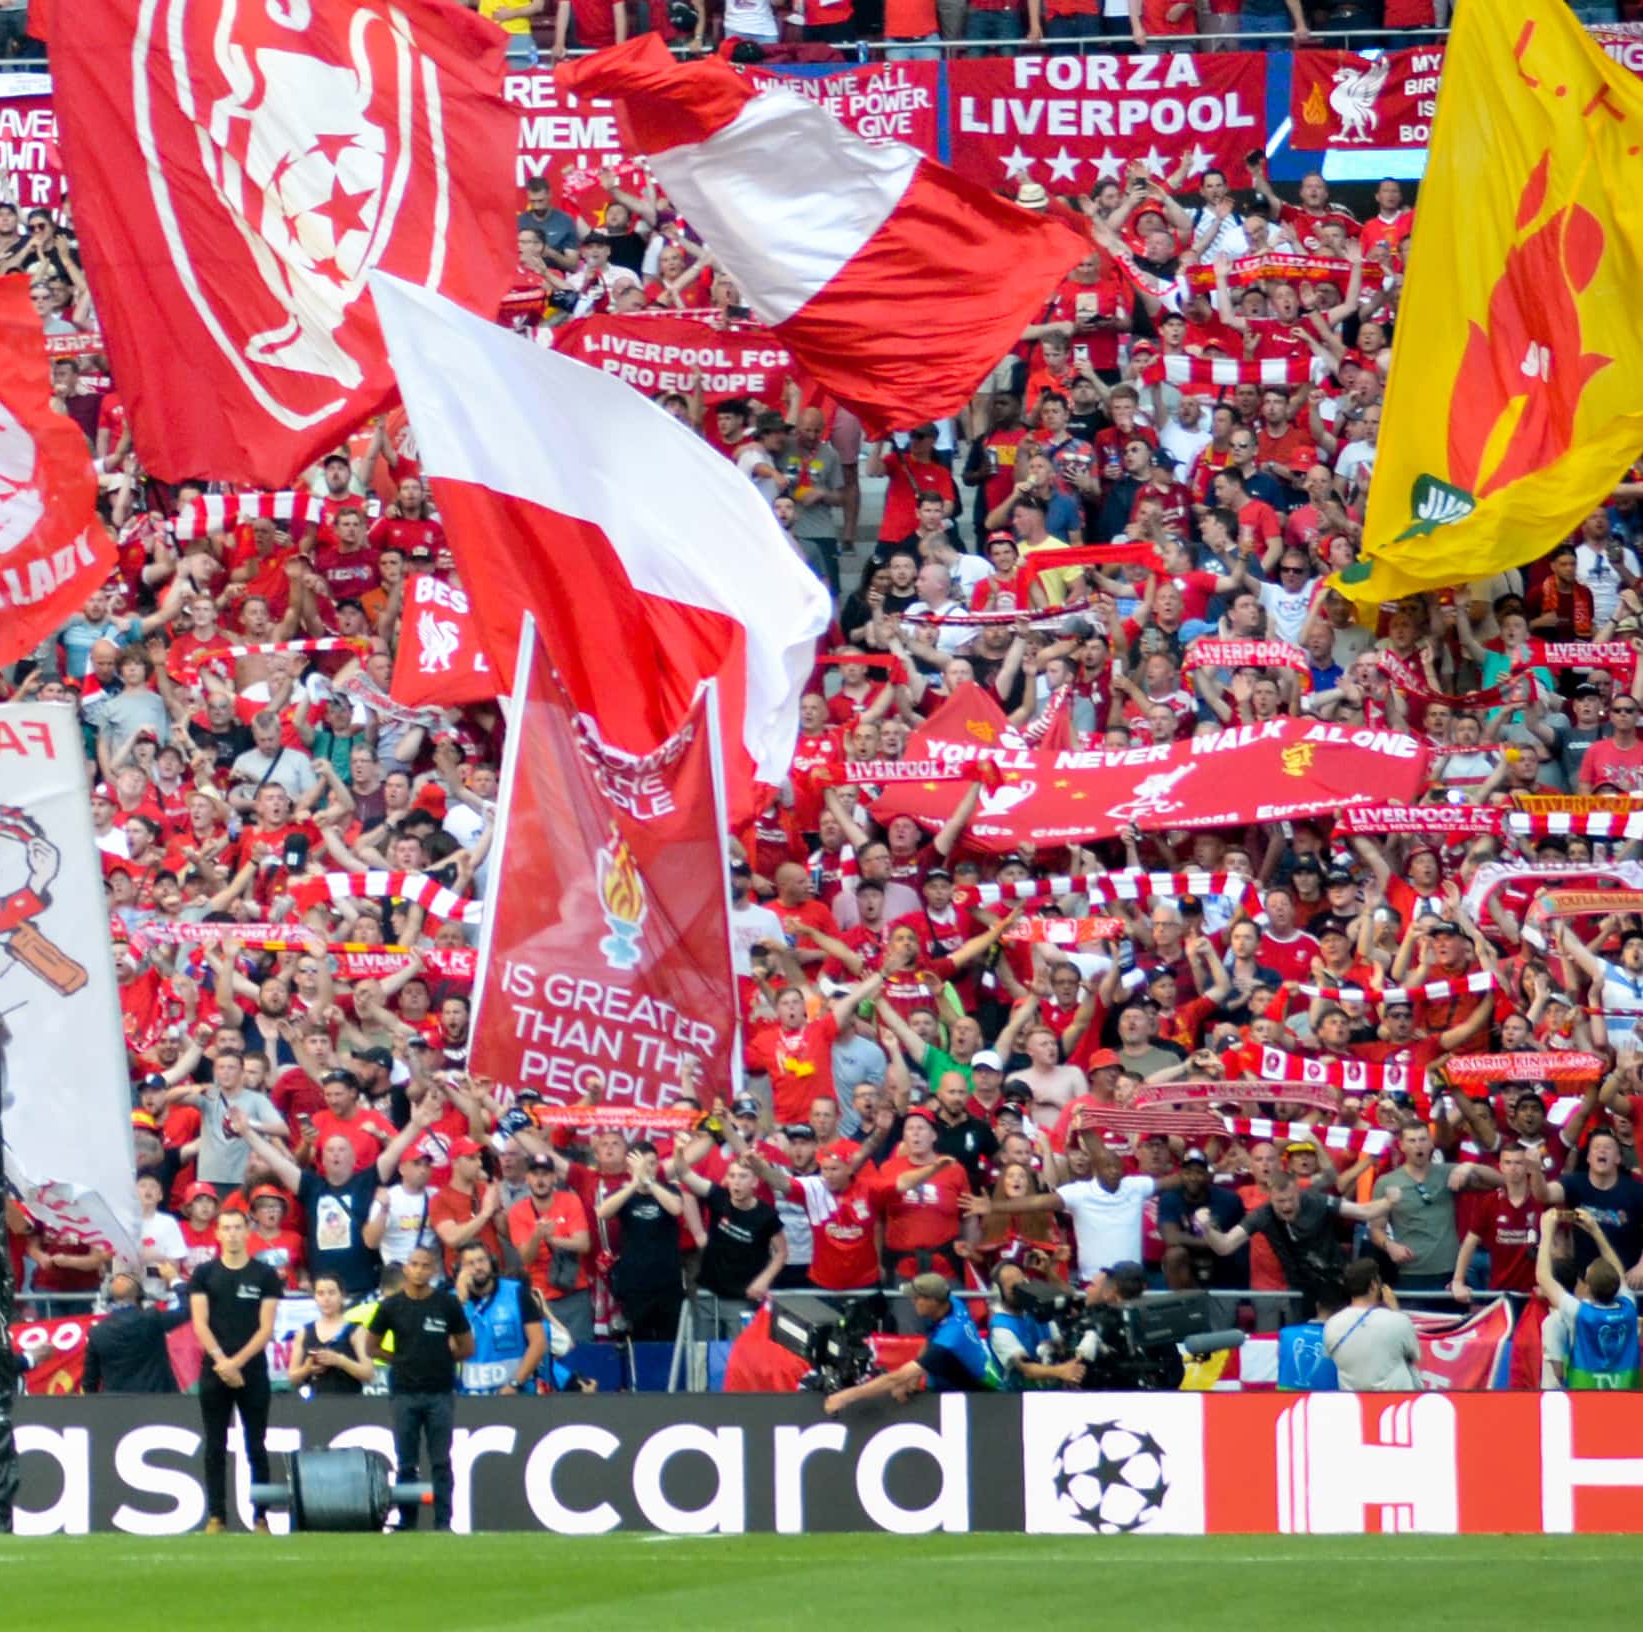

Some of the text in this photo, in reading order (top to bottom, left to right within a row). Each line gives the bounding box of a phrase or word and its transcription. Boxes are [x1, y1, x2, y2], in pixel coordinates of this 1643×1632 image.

[1013, 52, 1201, 91] FORZA
[848, 90, 931, 112] POWER
[959, 92, 1255, 136] LIVERPOOL
[856, 112, 914, 136] GIVE
[582, 334, 732, 368] LIVERPOOL
[1197, 639, 1298, 658] LIVERPOOL
[1545, 641, 1630, 658] LIVERPOOL
[925, 719, 1419, 771] YOU'LL NEVER WALK ALONE
[1348, 805, 1497, 827] LIVERPOOL FC
[501, 960, 717, 1058] IS GREATER
[511, 1004, 624, 1062] THAN
